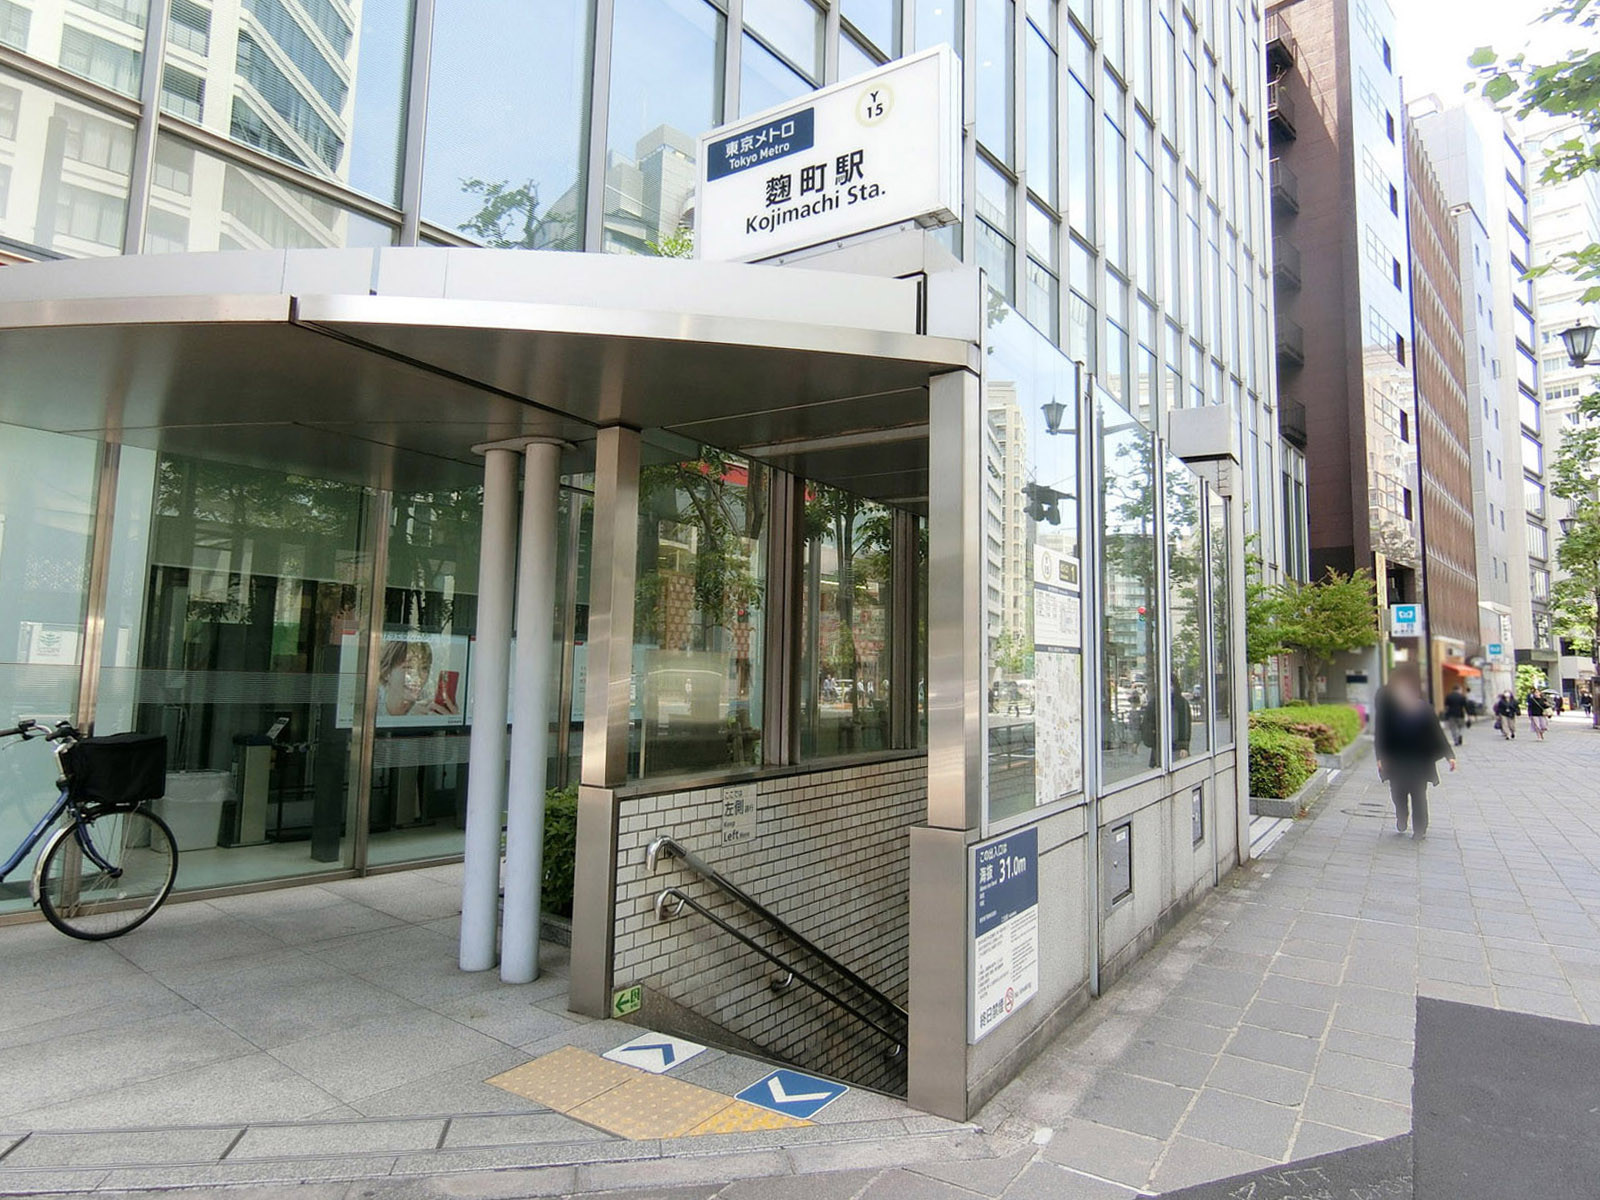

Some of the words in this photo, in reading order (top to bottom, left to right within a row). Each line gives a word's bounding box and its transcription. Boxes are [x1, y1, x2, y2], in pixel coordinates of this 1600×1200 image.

[870, 90, 879, 103] Y
[867, 104, 884, 119] 15
[725, 120, 795, 158] 東京メトロ
[729, 152, 757, 170] Tokyo
[760, 142, 790, 160] Metro
[746, 190, 840, 234] Kojimachi
[847, 183, 886, 205] Sta.
[724, 829, 739, 842] Left
[999, 856, 1026, 883] 31.0m
